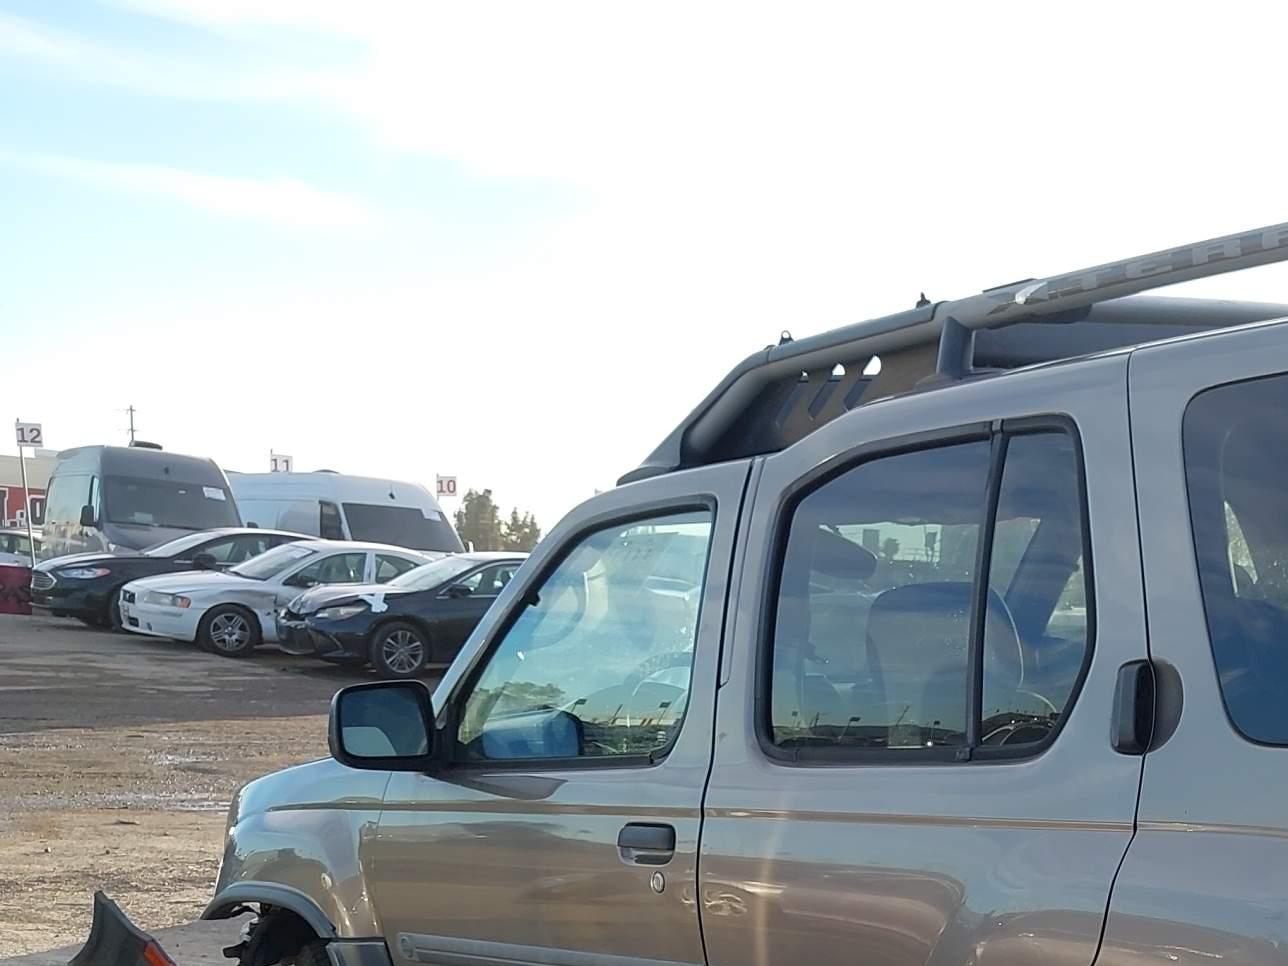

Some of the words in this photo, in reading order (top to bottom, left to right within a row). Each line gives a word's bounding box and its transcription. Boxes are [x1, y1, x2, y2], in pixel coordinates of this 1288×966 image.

[17, 427, 42, 444] 12
[272, 458, 290, 472] 11
[437, 479, 457, 493] 10
